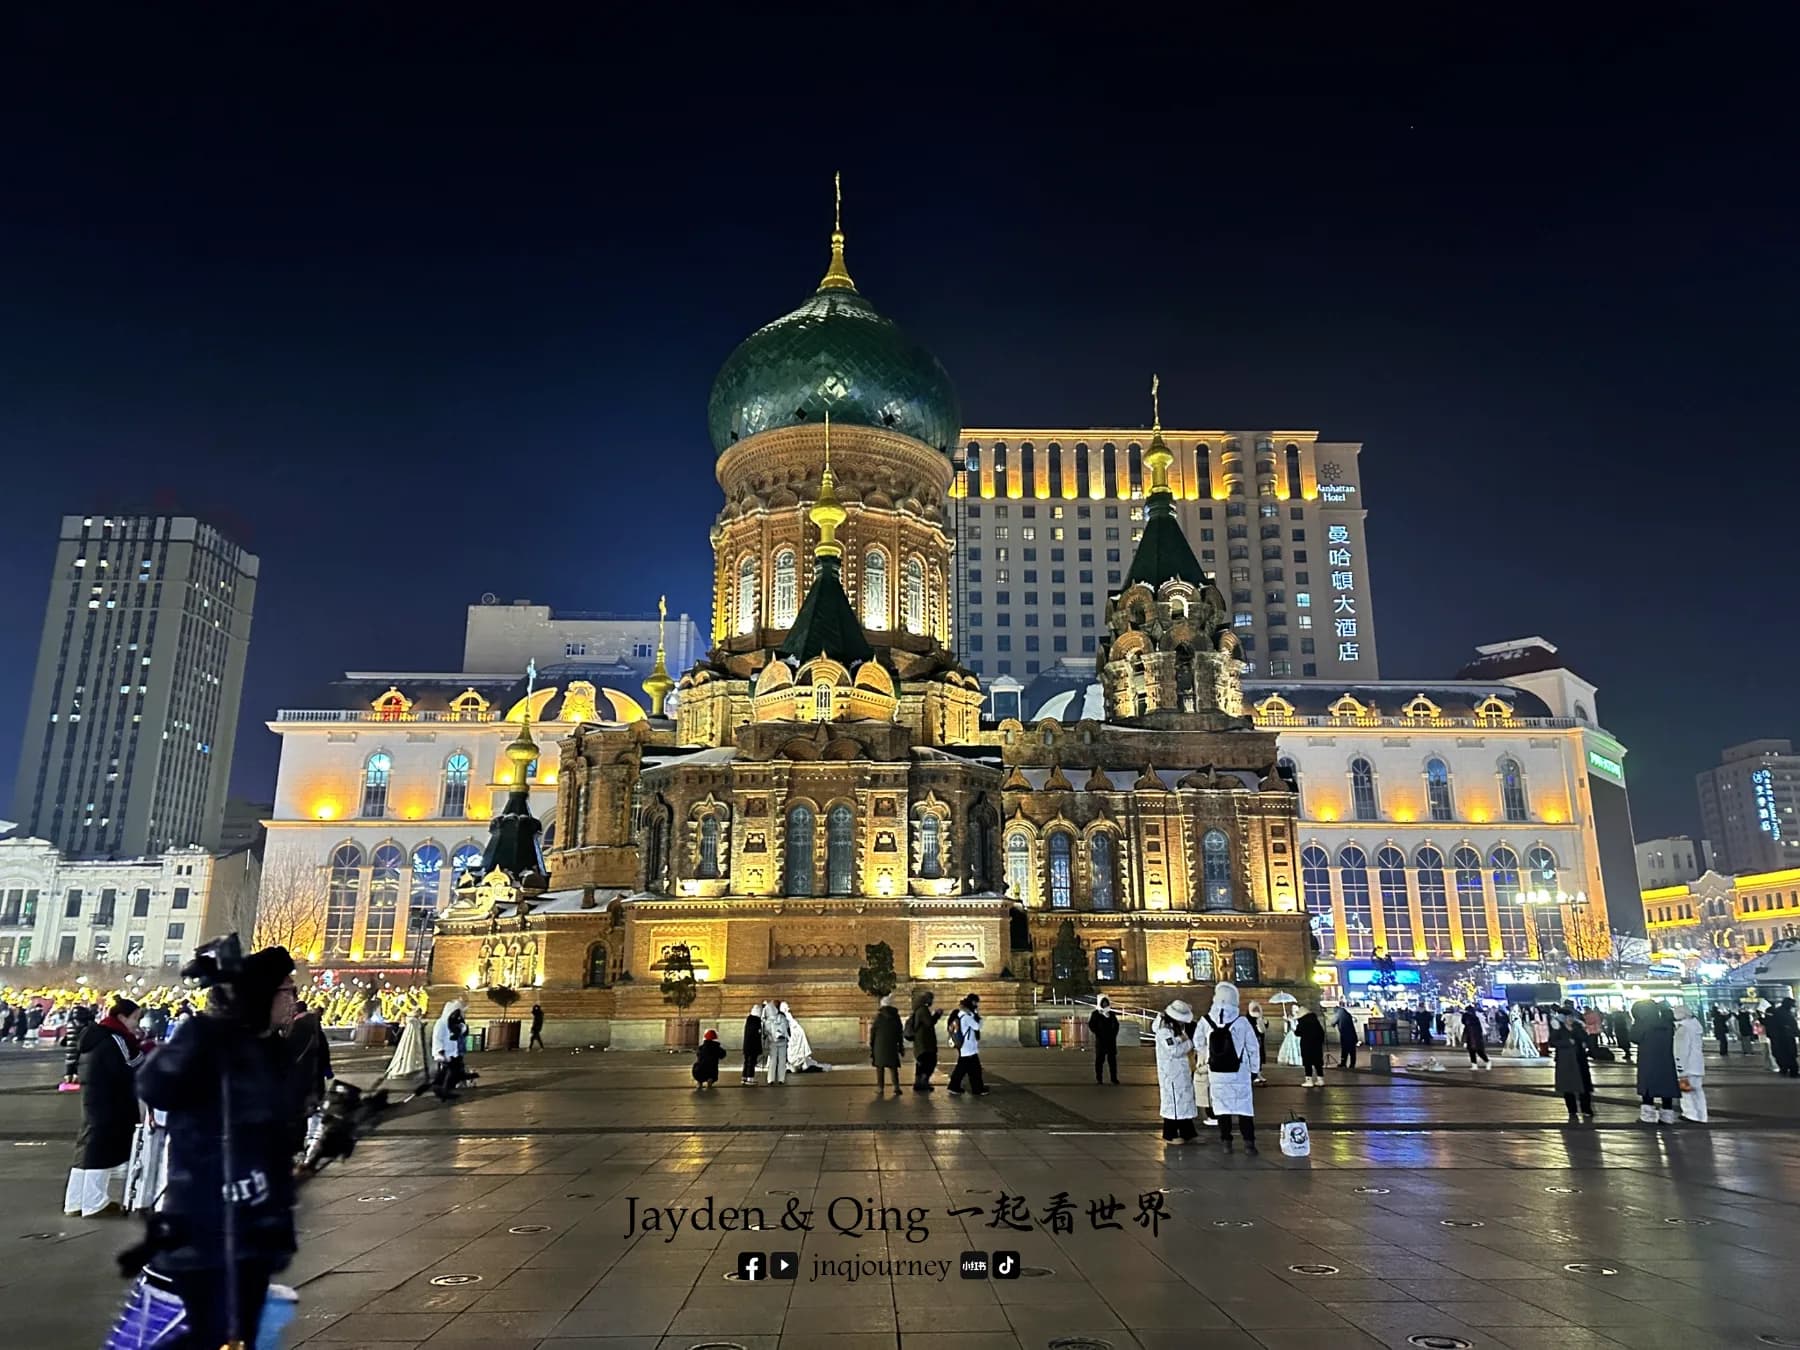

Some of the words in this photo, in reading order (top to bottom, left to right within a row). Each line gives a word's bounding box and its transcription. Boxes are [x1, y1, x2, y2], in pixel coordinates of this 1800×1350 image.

[1323, 492, 1346, 502] Hotel
[1328, 525, 1360, 662] 曼哈頓大酒店
